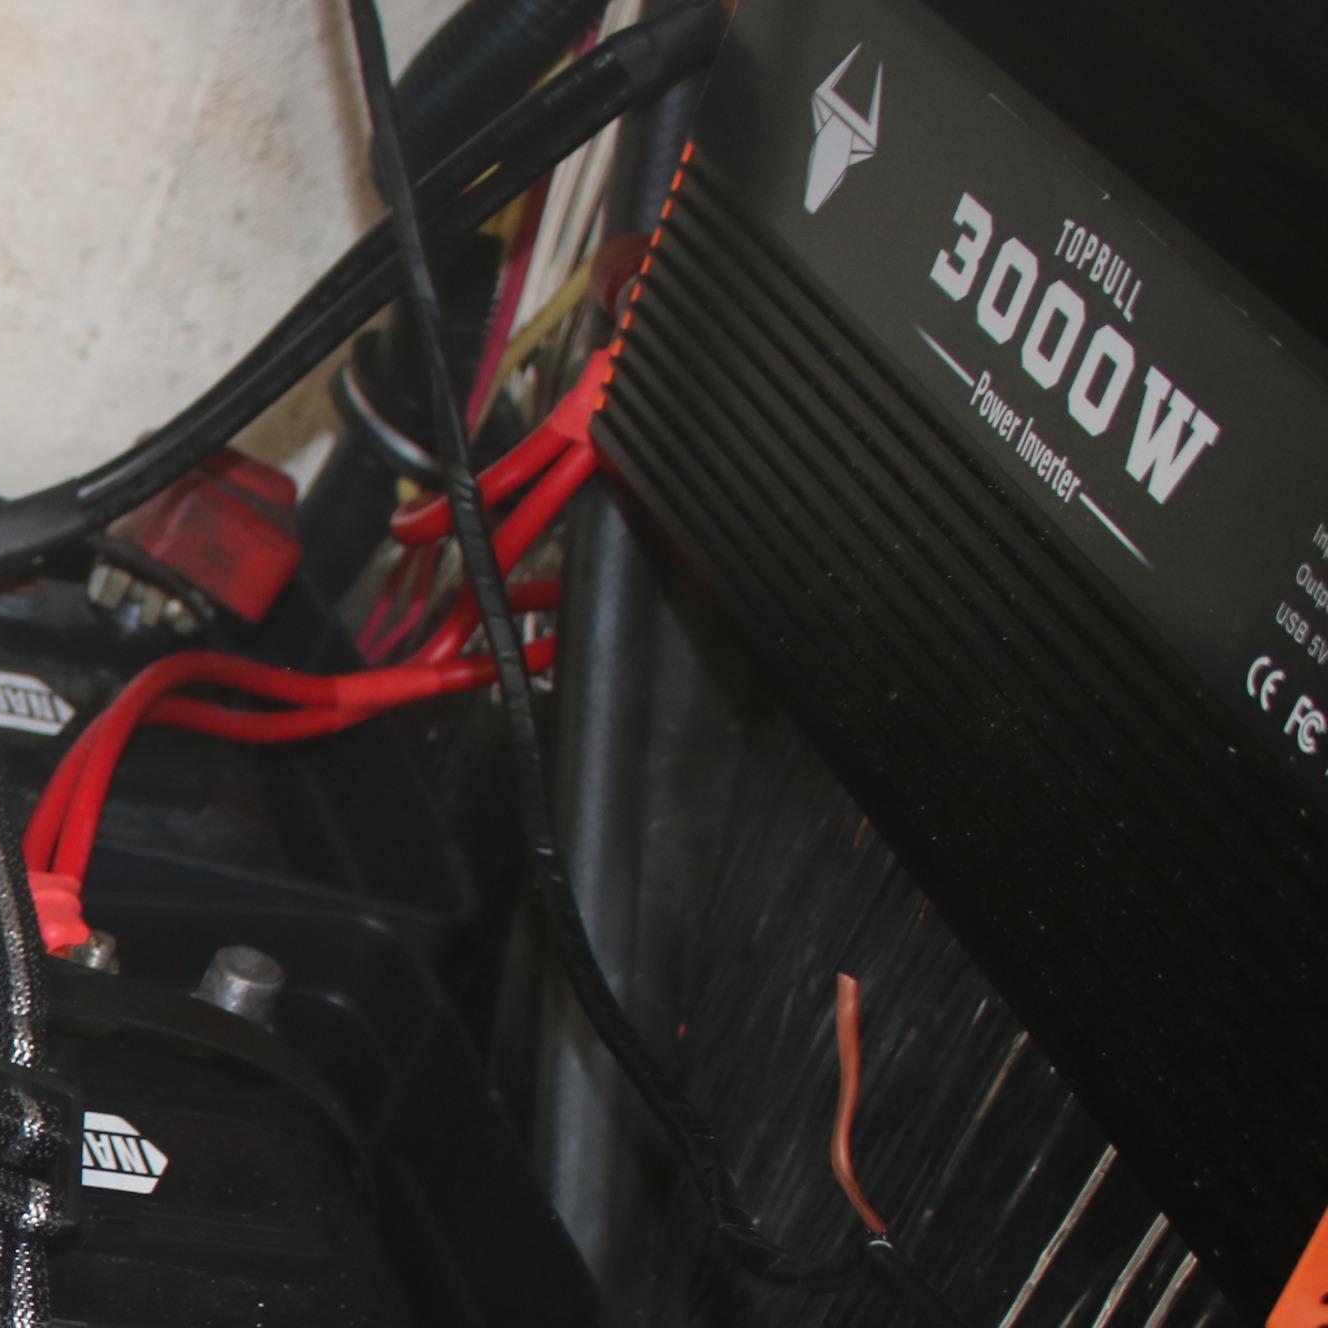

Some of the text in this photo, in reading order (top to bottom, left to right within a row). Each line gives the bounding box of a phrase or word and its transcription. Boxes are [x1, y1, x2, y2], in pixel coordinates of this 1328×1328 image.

[1053, 219, 1142, 323] TOPBULL
[930, 192, 1219, 504] 3000W
[970, 370, 1081, 504] Power Inverter
[1276, 601, 1309, 643] USB
[1296, 564, 1328, 613] Outp
